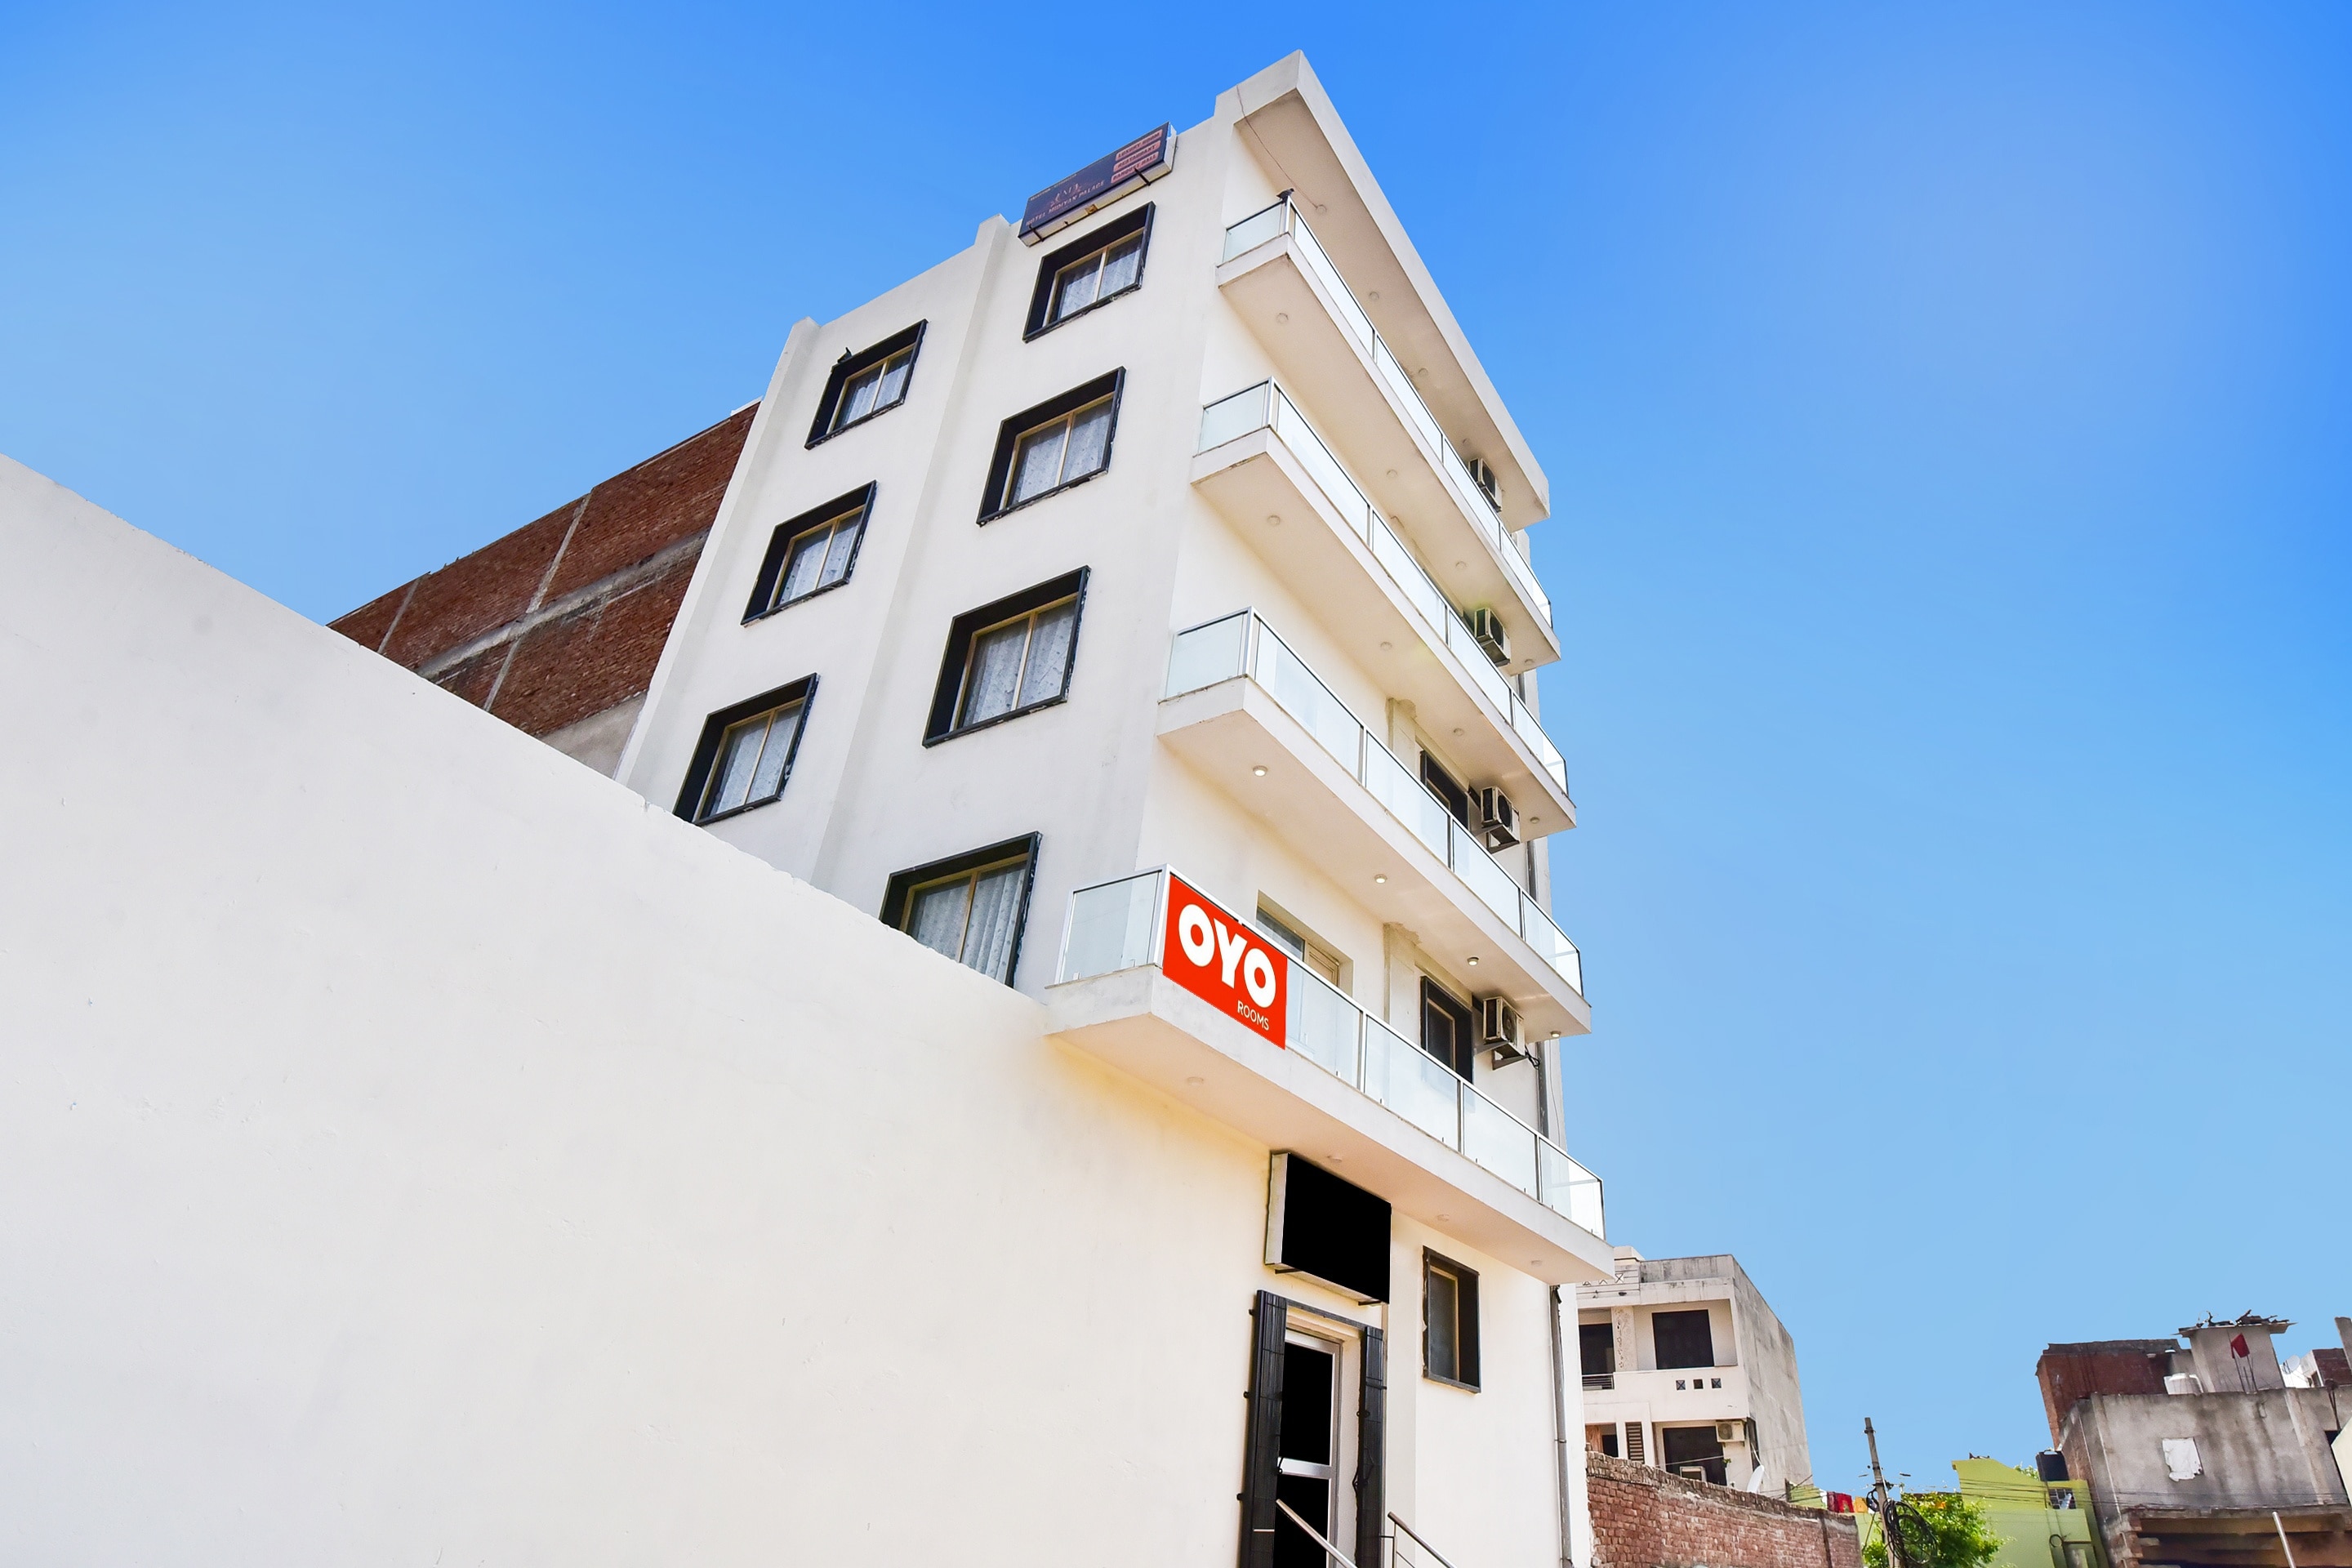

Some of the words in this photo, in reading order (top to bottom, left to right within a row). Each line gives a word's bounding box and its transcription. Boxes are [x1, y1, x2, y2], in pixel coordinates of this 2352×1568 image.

[1117, 145, 1156, 167] RESTAURANT
[1141, 154, 1156, 166] HALL
[1026, 212, 1045, 226] HOTEL
[1078, 180, 1105, 198] PALACE
[1178, 903, 1276, 1009] OYO
[1237, 1000, 1270, 1031] ROOMS
